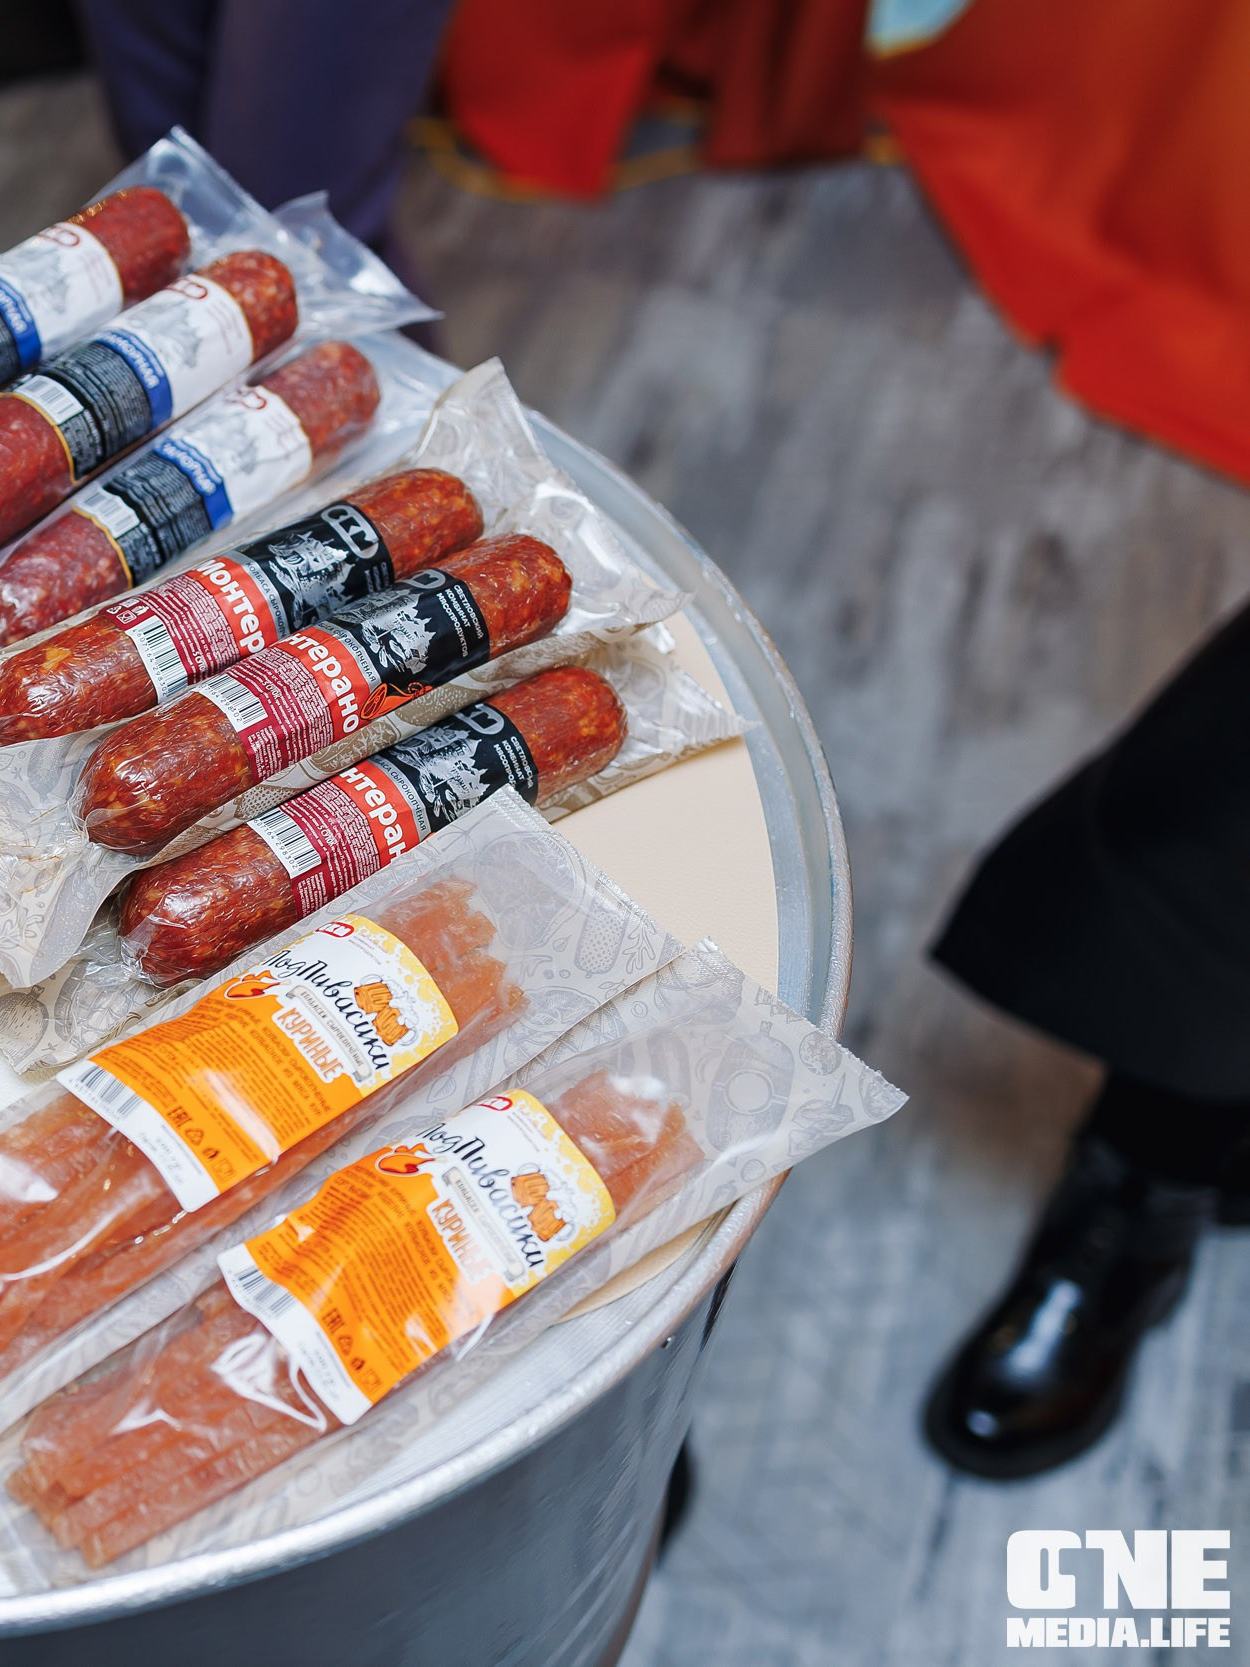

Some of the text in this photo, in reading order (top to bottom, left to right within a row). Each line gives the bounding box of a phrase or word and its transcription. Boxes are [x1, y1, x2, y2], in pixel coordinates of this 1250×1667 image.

[245, 560, 289, 638] КОЛБАСА СЫРОКОПЧ
[436, 592, 468, 657] МЯСОПРОДУКТОВ
[444, 588, 471, 627] КОМБИНАТ
[453, 584, 483, 638] СВЕТЛОВСКИЙ
[133, 630, 171, 696] 607164 298302
[331, 626, 379, 684] СЫРОКОПЧЕНАЯ
[218, 697, 243, 724] 298302
[501, 738, 525, 781] КОМБИНАТ
[388, 769, 429, 832] СЫРОКОПЧЕНАЯ
[252, 817, 299, 871] 607164 298302
[263, 948, 389, 1070] ПодПивасики
[277, 1006, 343, 1080] КУРИНЫЕ
